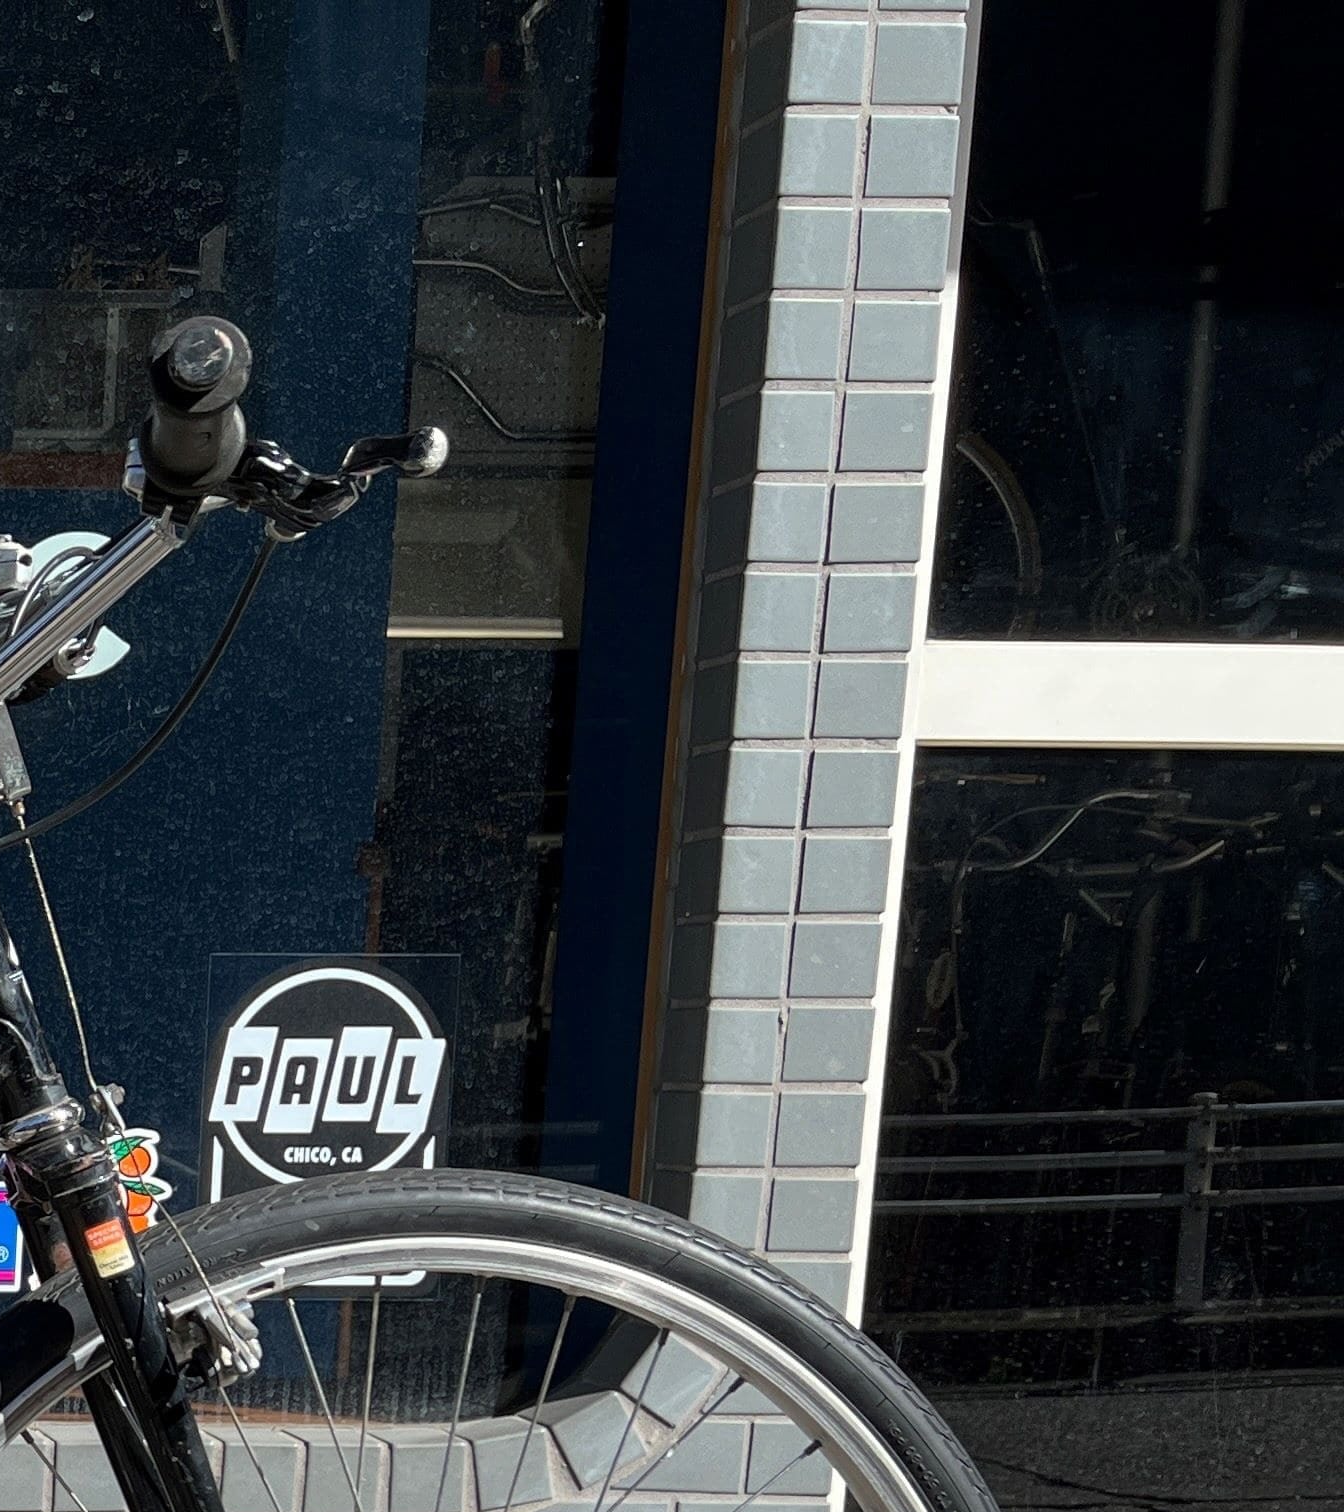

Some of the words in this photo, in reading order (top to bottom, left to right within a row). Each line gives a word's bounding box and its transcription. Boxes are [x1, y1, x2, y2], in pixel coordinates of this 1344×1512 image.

[222, 1052, 428, 1109] PAUL
[283, 1145, 342, 1166] CHICO,
[344, 1146, 363, 1165] CA
